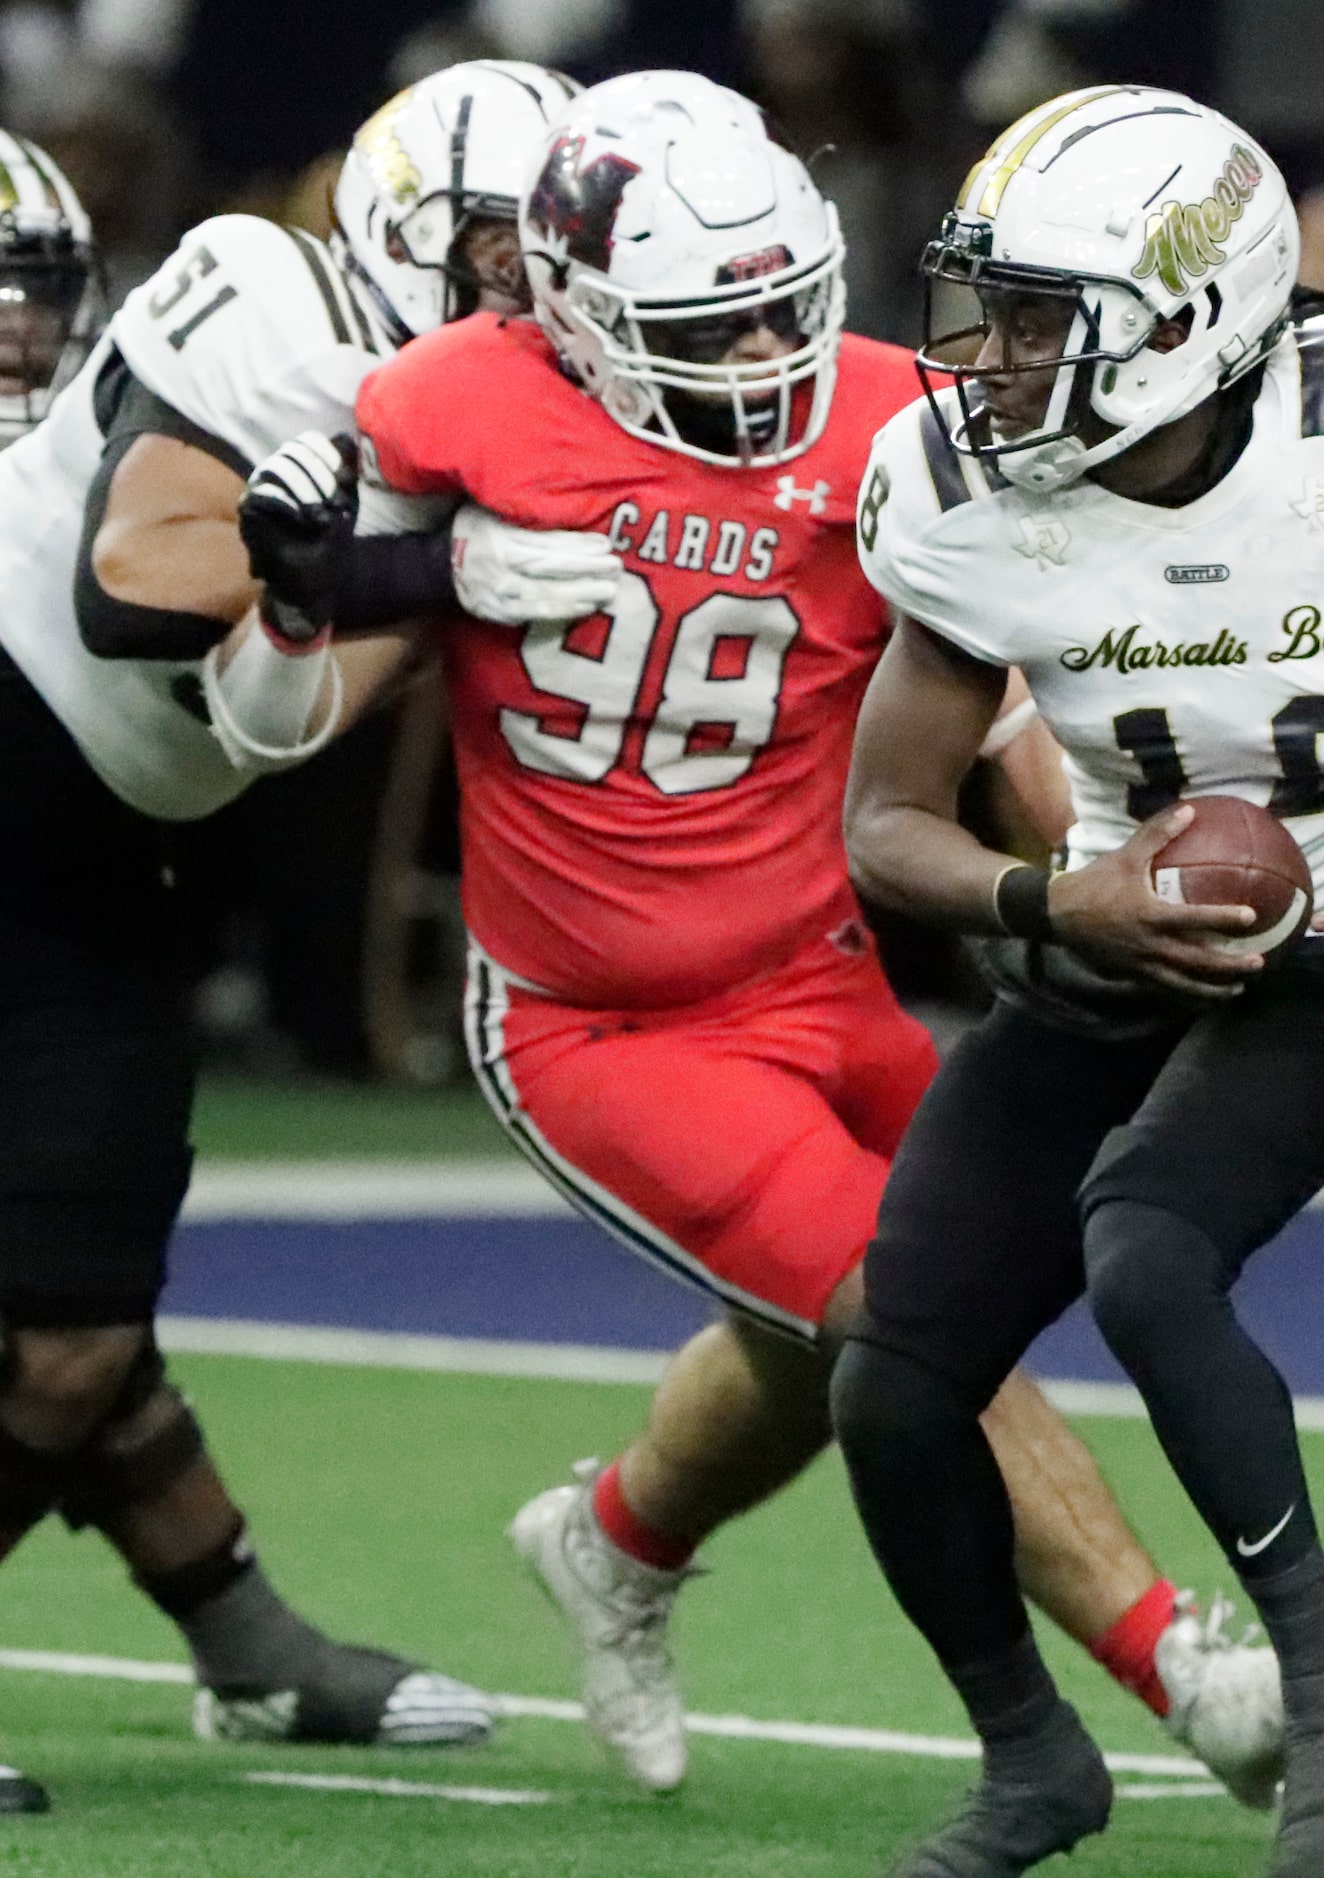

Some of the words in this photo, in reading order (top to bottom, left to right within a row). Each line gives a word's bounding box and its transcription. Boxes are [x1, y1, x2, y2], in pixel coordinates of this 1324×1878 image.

[148, 245, 239, 352] 51
[607, 502, 779, 582] CARDS
[1168, 566, 1226, 582] BATTLE
[500, 566, 800, 795] 98
[1060, 624, 1249, 675] Marsalis
